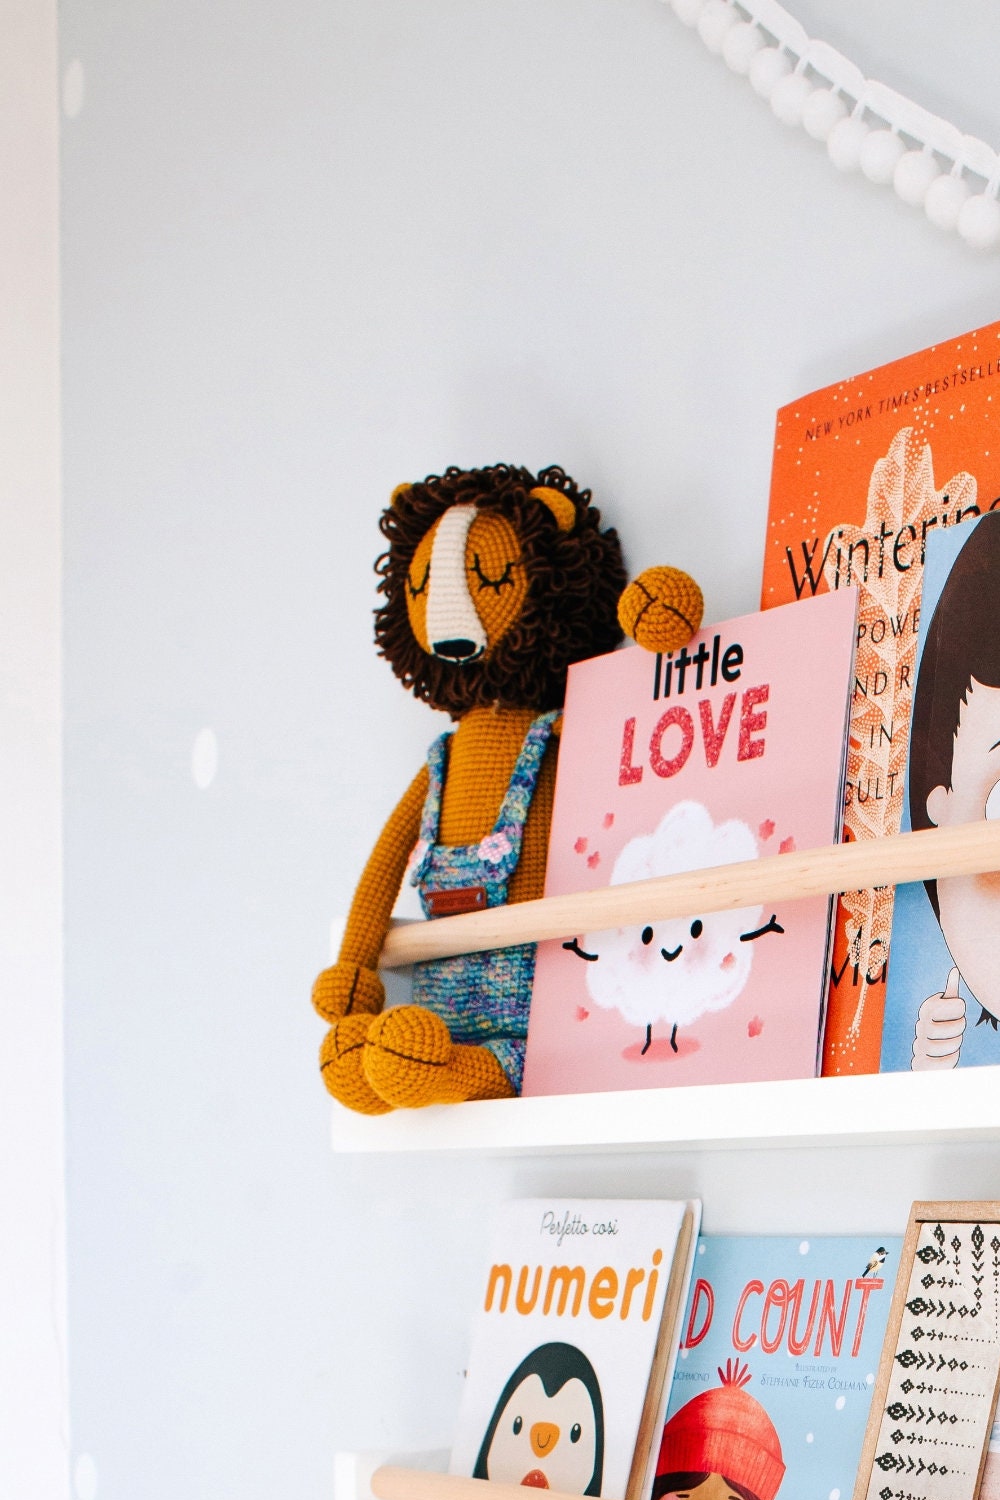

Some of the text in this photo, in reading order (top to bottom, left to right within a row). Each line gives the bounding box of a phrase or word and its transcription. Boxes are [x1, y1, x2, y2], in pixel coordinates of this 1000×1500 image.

[805, 421, 834, 442] NEW
[838, 406, 873, 428] YORK
[879, 387, 920, 414] TIMES
[652, 634, 744, 701] little
[617, 683, 770, 787] LOVE
[870, 720, 894, 749] IN
[539, 1210, 590, 1247] Perfetto
[483, 1248, 663, 1322] numeri
[731, 1278, 885, 1358] COUNT
